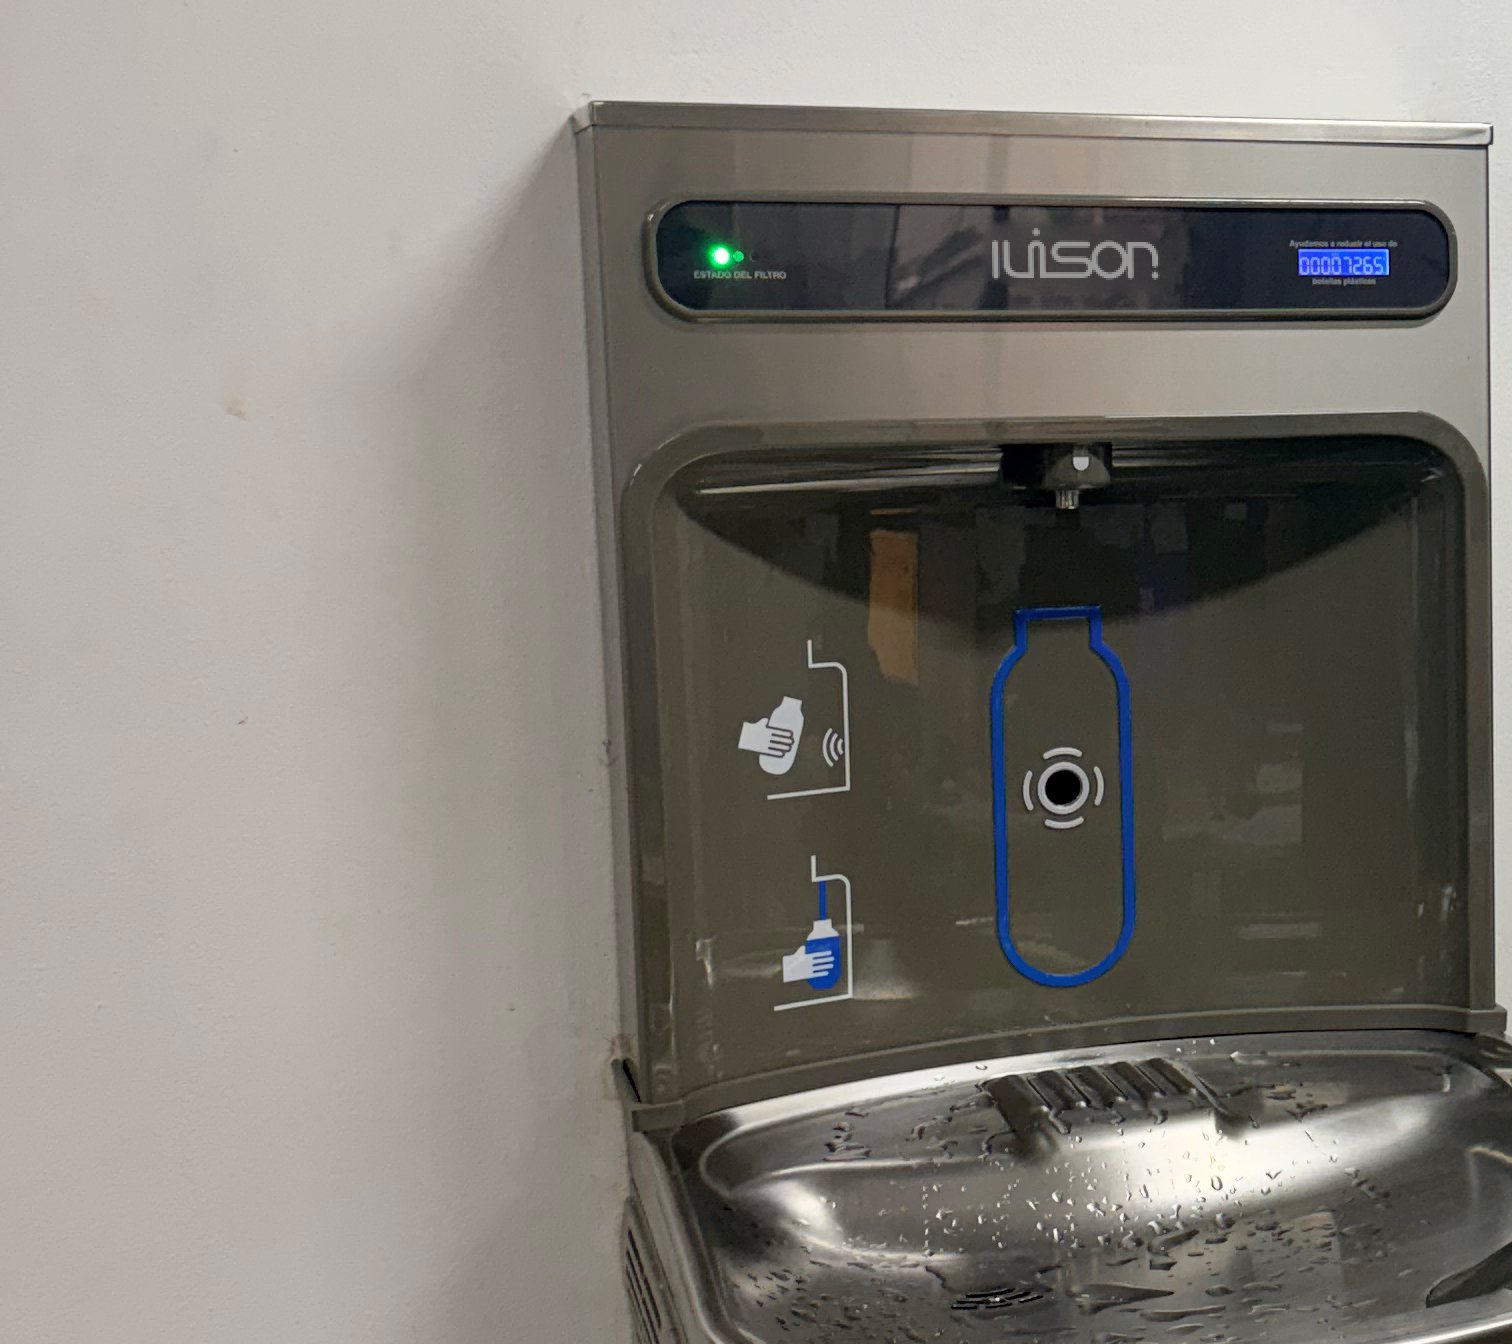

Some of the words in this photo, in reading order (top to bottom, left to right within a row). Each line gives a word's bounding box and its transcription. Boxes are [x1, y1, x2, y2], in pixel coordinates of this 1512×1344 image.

[1299, 256, 1384, 275] 00007265
[693, 270, 732, 280] ESTADO
[734, 271, 752, 280] DEL
[754, 271, 787, 280] FILTRO
